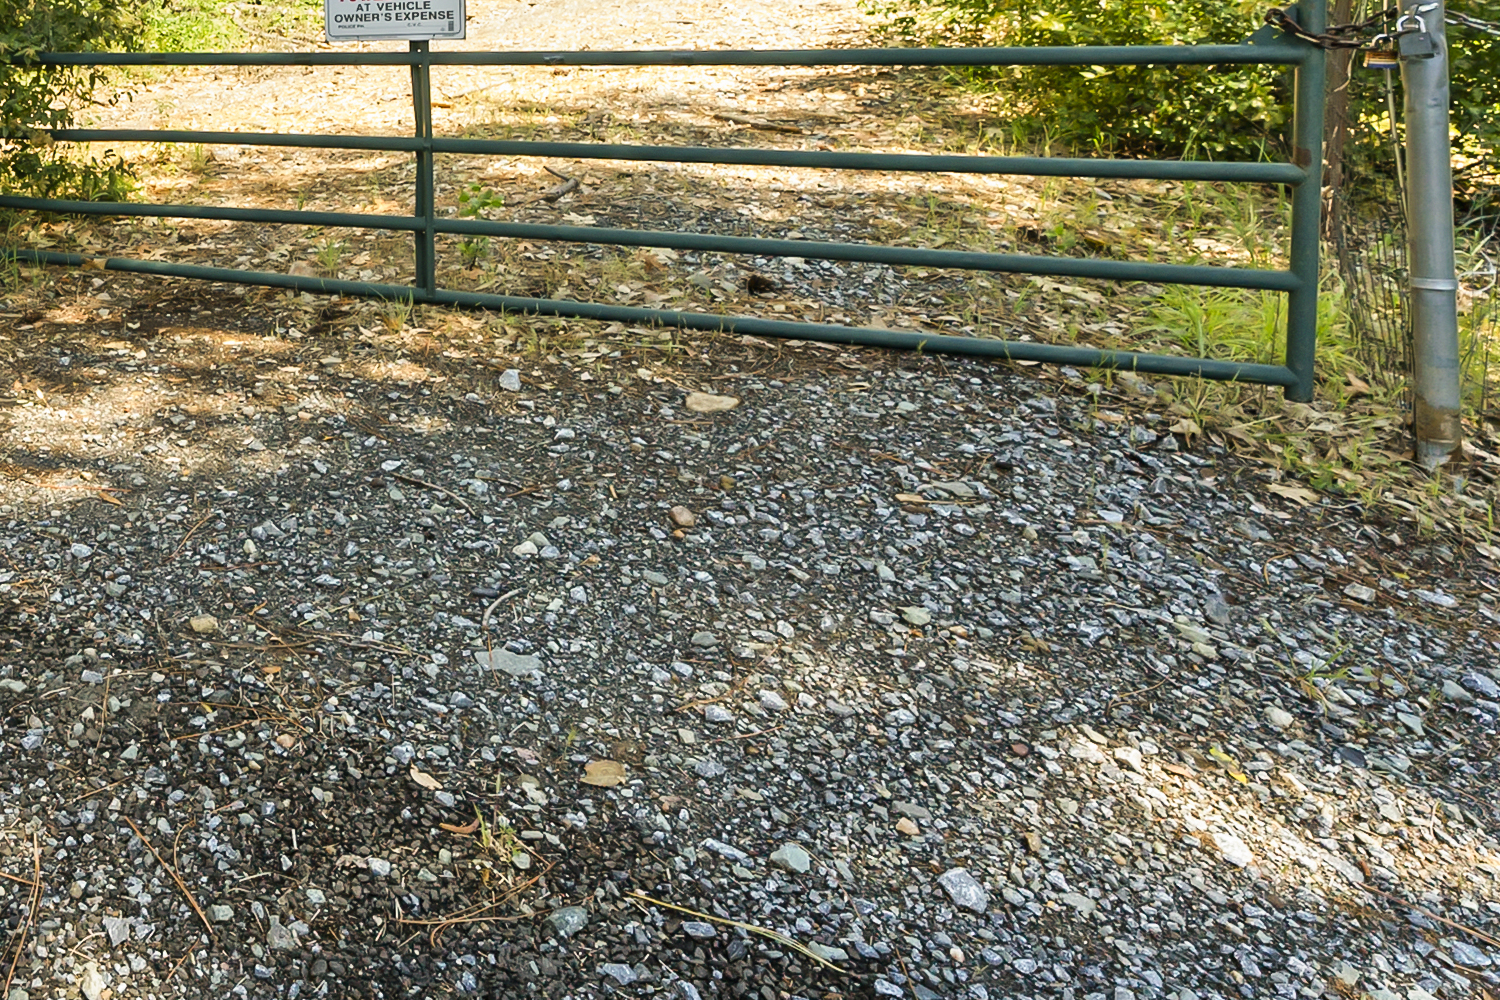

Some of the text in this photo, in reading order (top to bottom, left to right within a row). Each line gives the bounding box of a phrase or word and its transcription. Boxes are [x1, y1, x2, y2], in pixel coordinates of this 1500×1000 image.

[356, 0, 431, 12] AT VEHICLE
[334, 10, 454, 23] OWNER'S EXPENSE
